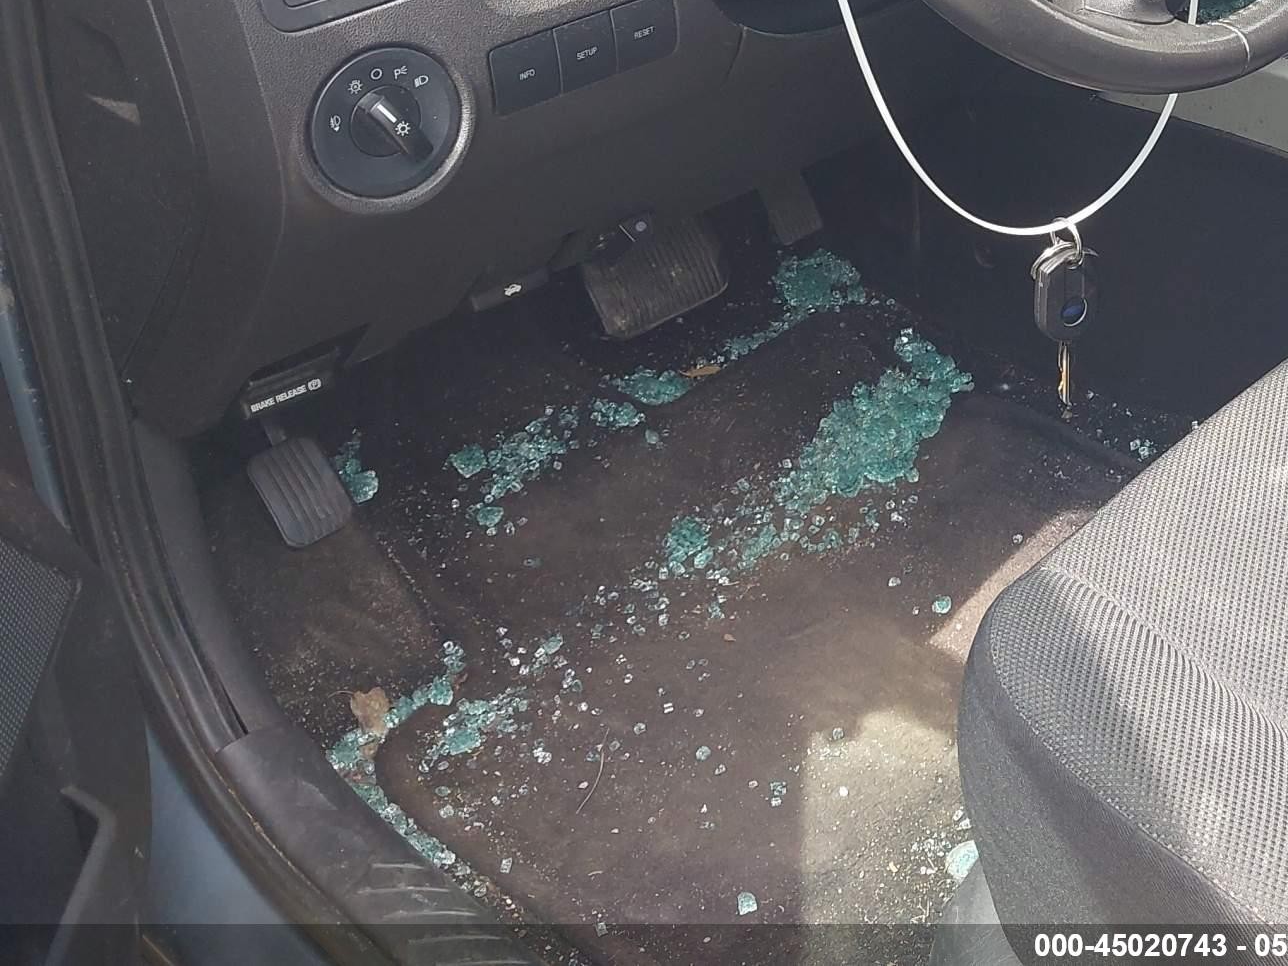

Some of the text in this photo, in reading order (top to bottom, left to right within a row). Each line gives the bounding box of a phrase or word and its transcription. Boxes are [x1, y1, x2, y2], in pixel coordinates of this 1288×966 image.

[634, 26, 655, 39] RESET
[576, 47, 598, 60] SETUP
[519, 69, 535, 81] INFO
[251, 385, 307, 412] BRAKE RELEASE
